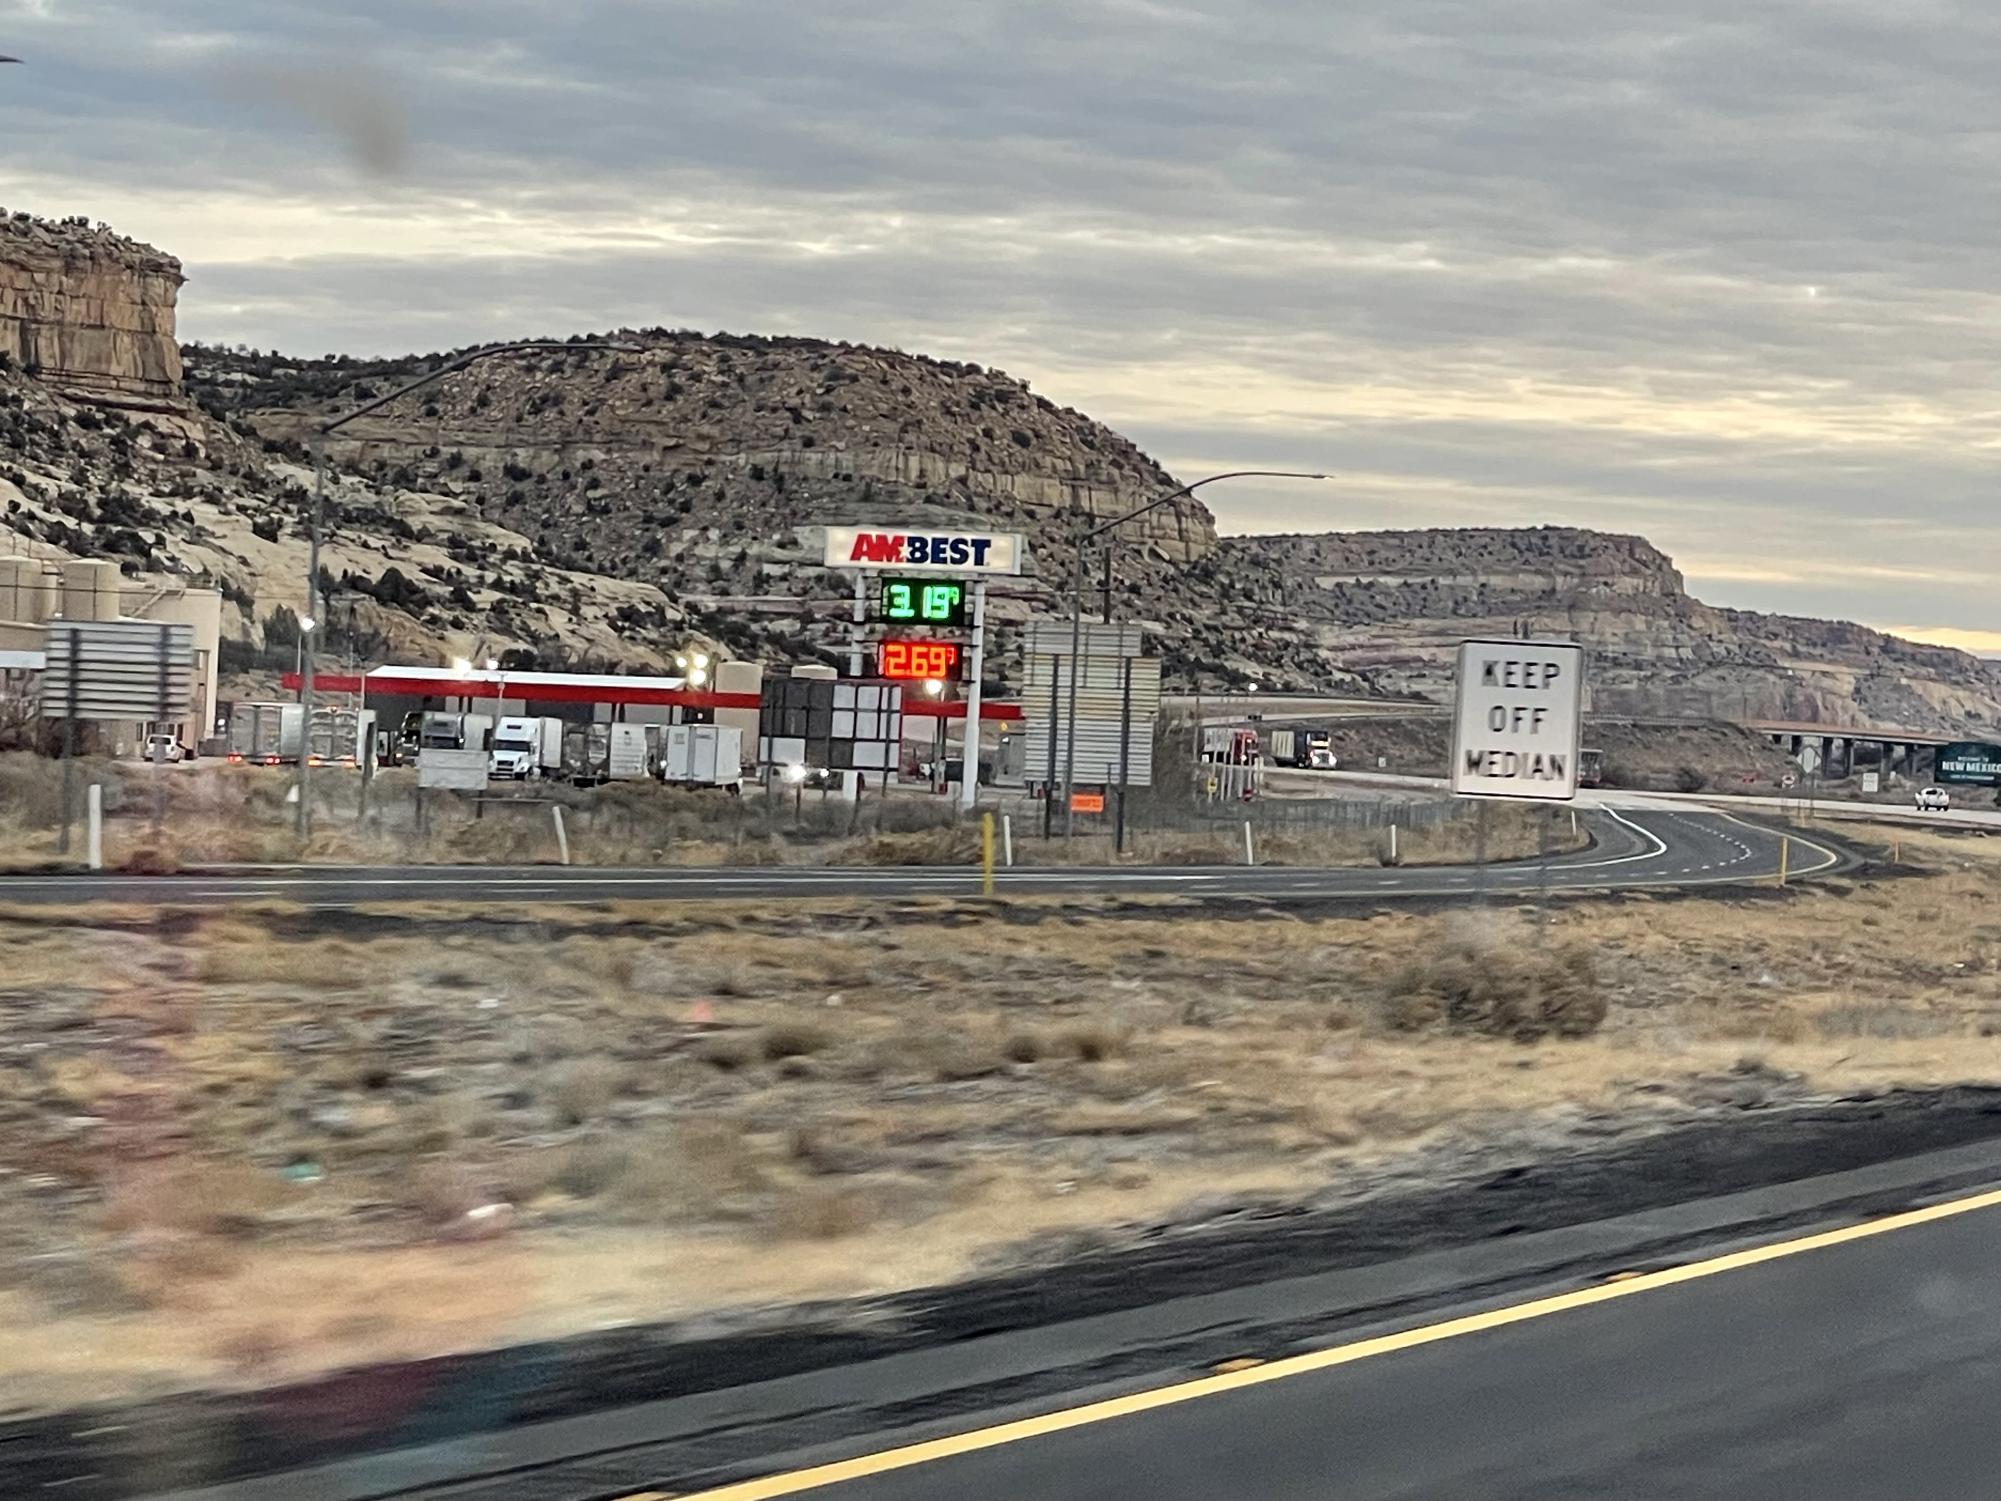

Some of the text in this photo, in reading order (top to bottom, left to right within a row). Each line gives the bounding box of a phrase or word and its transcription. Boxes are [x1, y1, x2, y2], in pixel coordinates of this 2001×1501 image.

[850, 533, 991, 566] AMBEST
[1482, 660, 1560, 689] KEEP
[1488, 705, 1548, 734] OFF
[1465, 750, 1567, 781] MEDIAN
[1942, 761, 1965, 771] NEW
